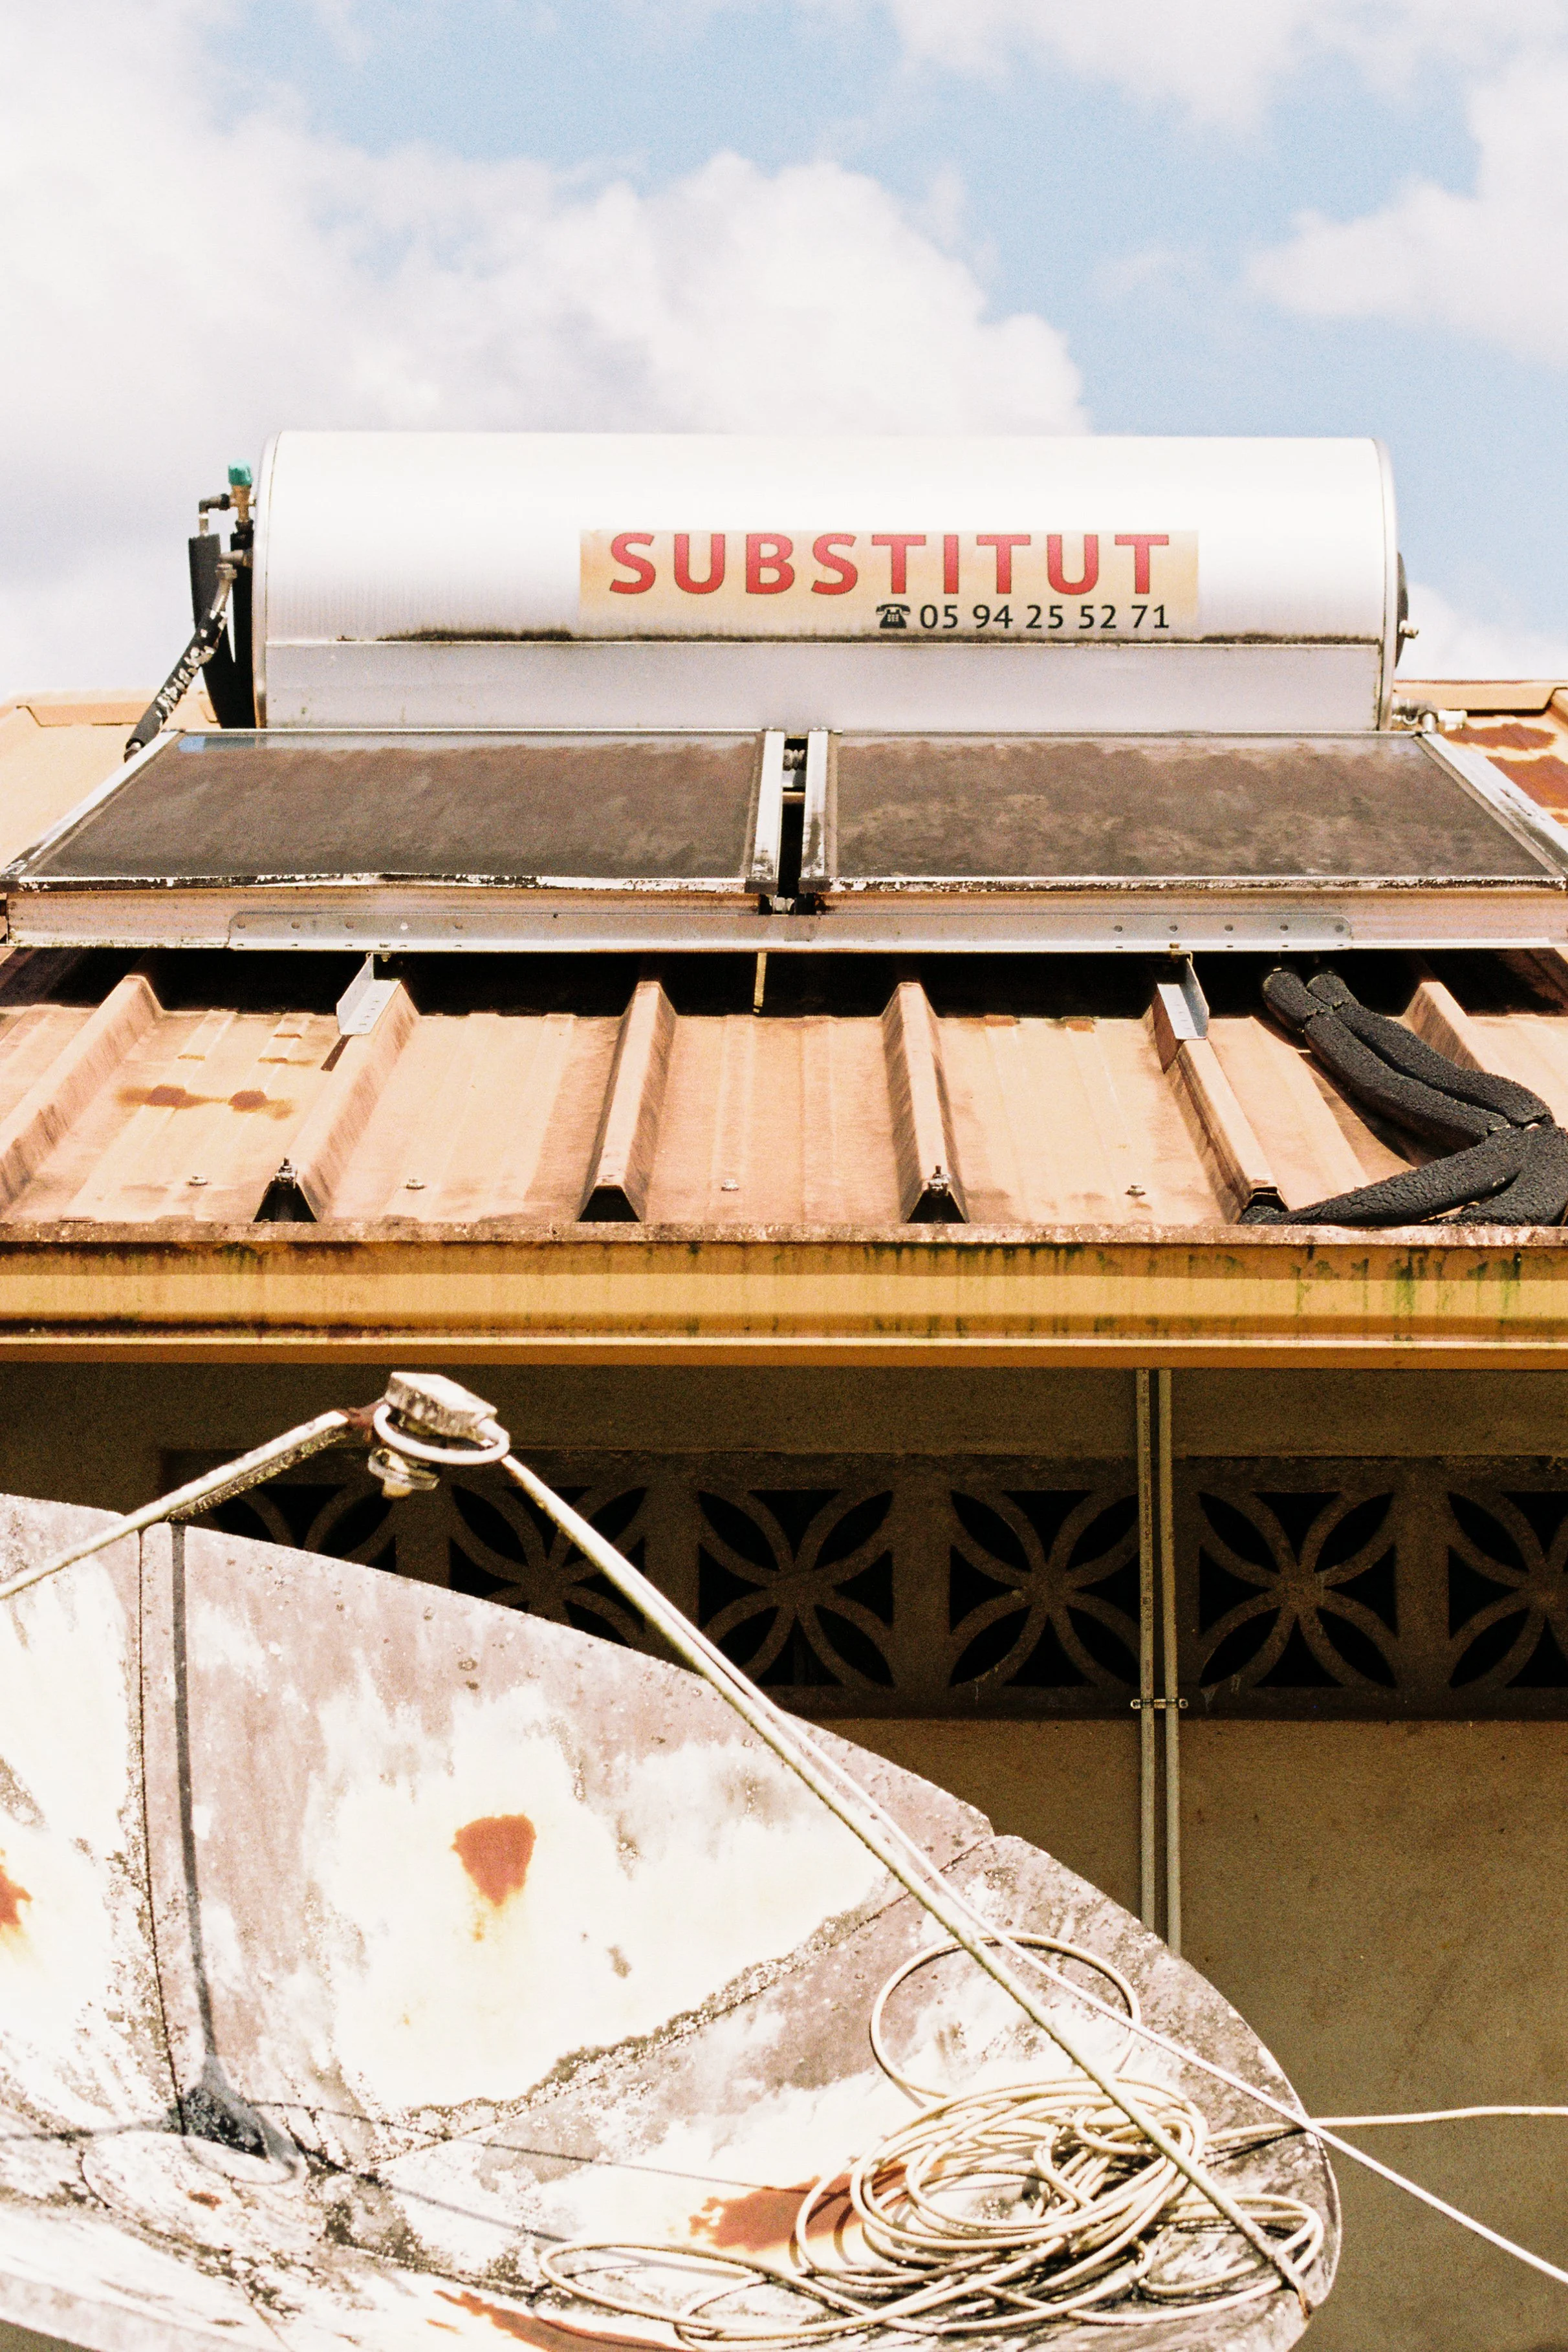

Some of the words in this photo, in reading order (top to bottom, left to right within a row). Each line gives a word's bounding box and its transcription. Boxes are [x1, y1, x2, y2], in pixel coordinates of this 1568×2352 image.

[609, 532, 1170, 595] SUBSTITUT
[919, 604, 959, 629] 05
[972, 604, 1014, 629] 94
[1025, 604, 1064, 629] 25
[1078, 604, 1116, 629] 52
[1131, 604, 1170, 629] 71
